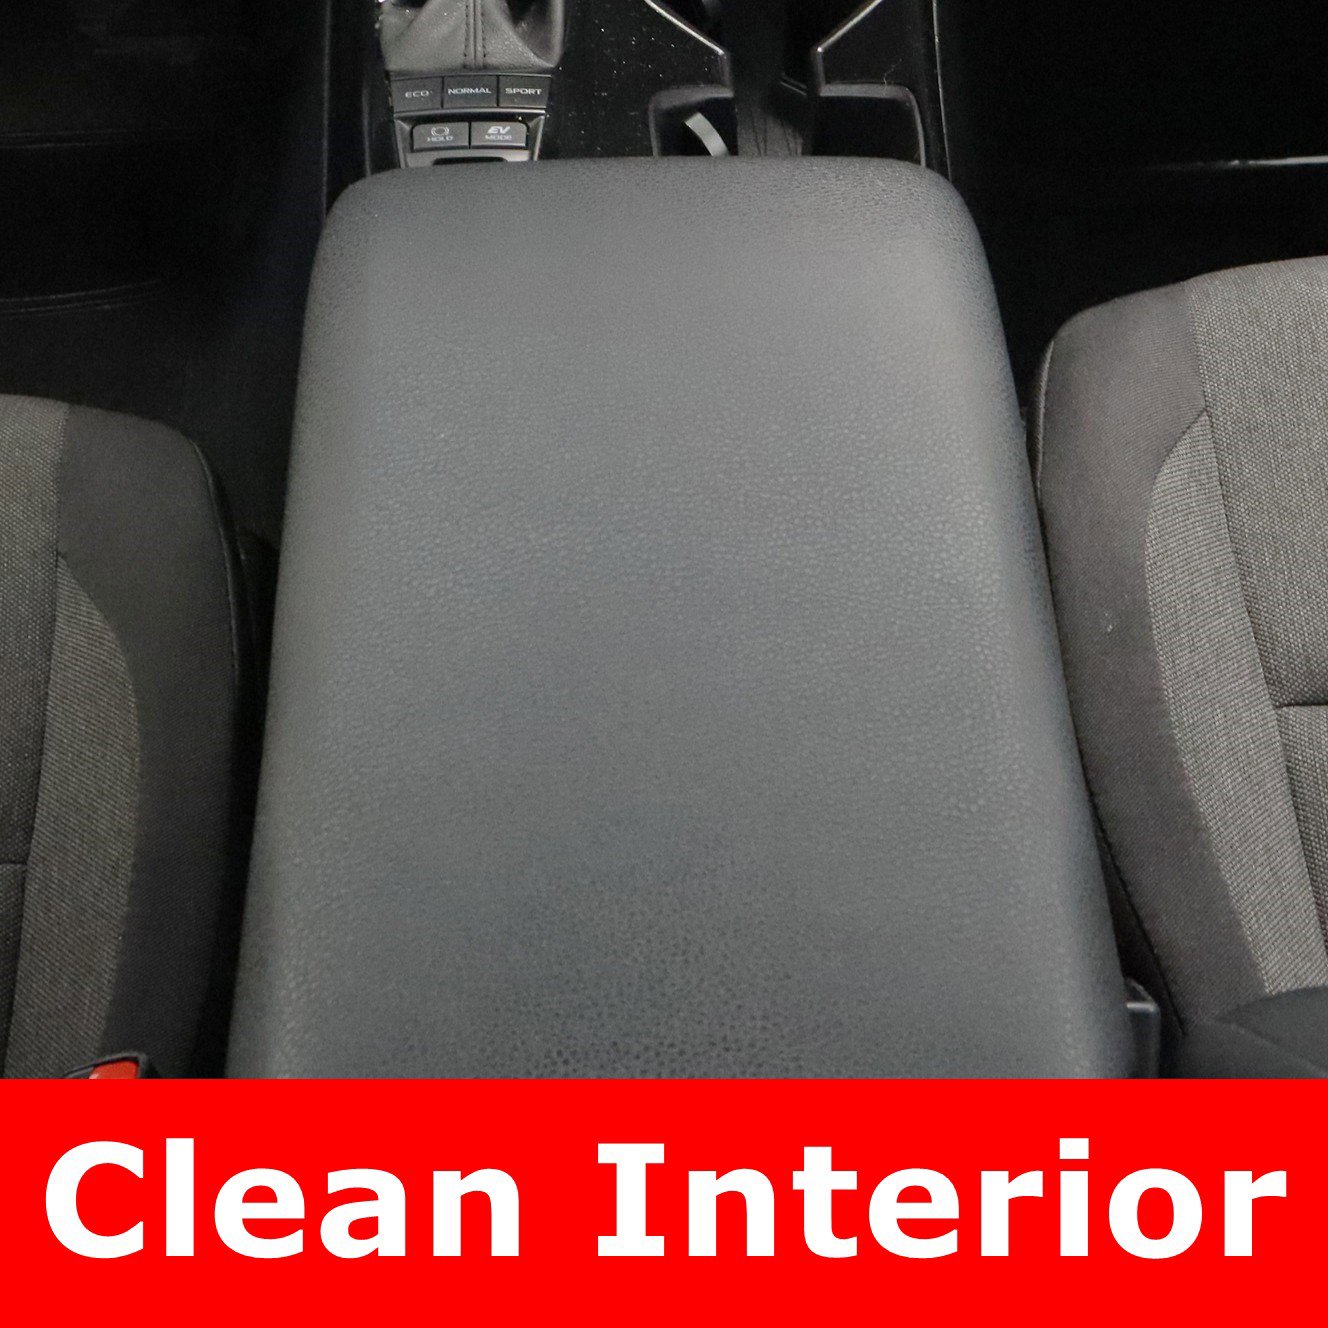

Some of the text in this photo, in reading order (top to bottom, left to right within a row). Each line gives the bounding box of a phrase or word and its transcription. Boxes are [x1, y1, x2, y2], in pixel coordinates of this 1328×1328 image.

[404, 90, 430, 98] ECO
[447, 87, 492, 95] NORMAL
[504, 87, 542, 95] SPORT
[487, 125, 511, 134] EV
